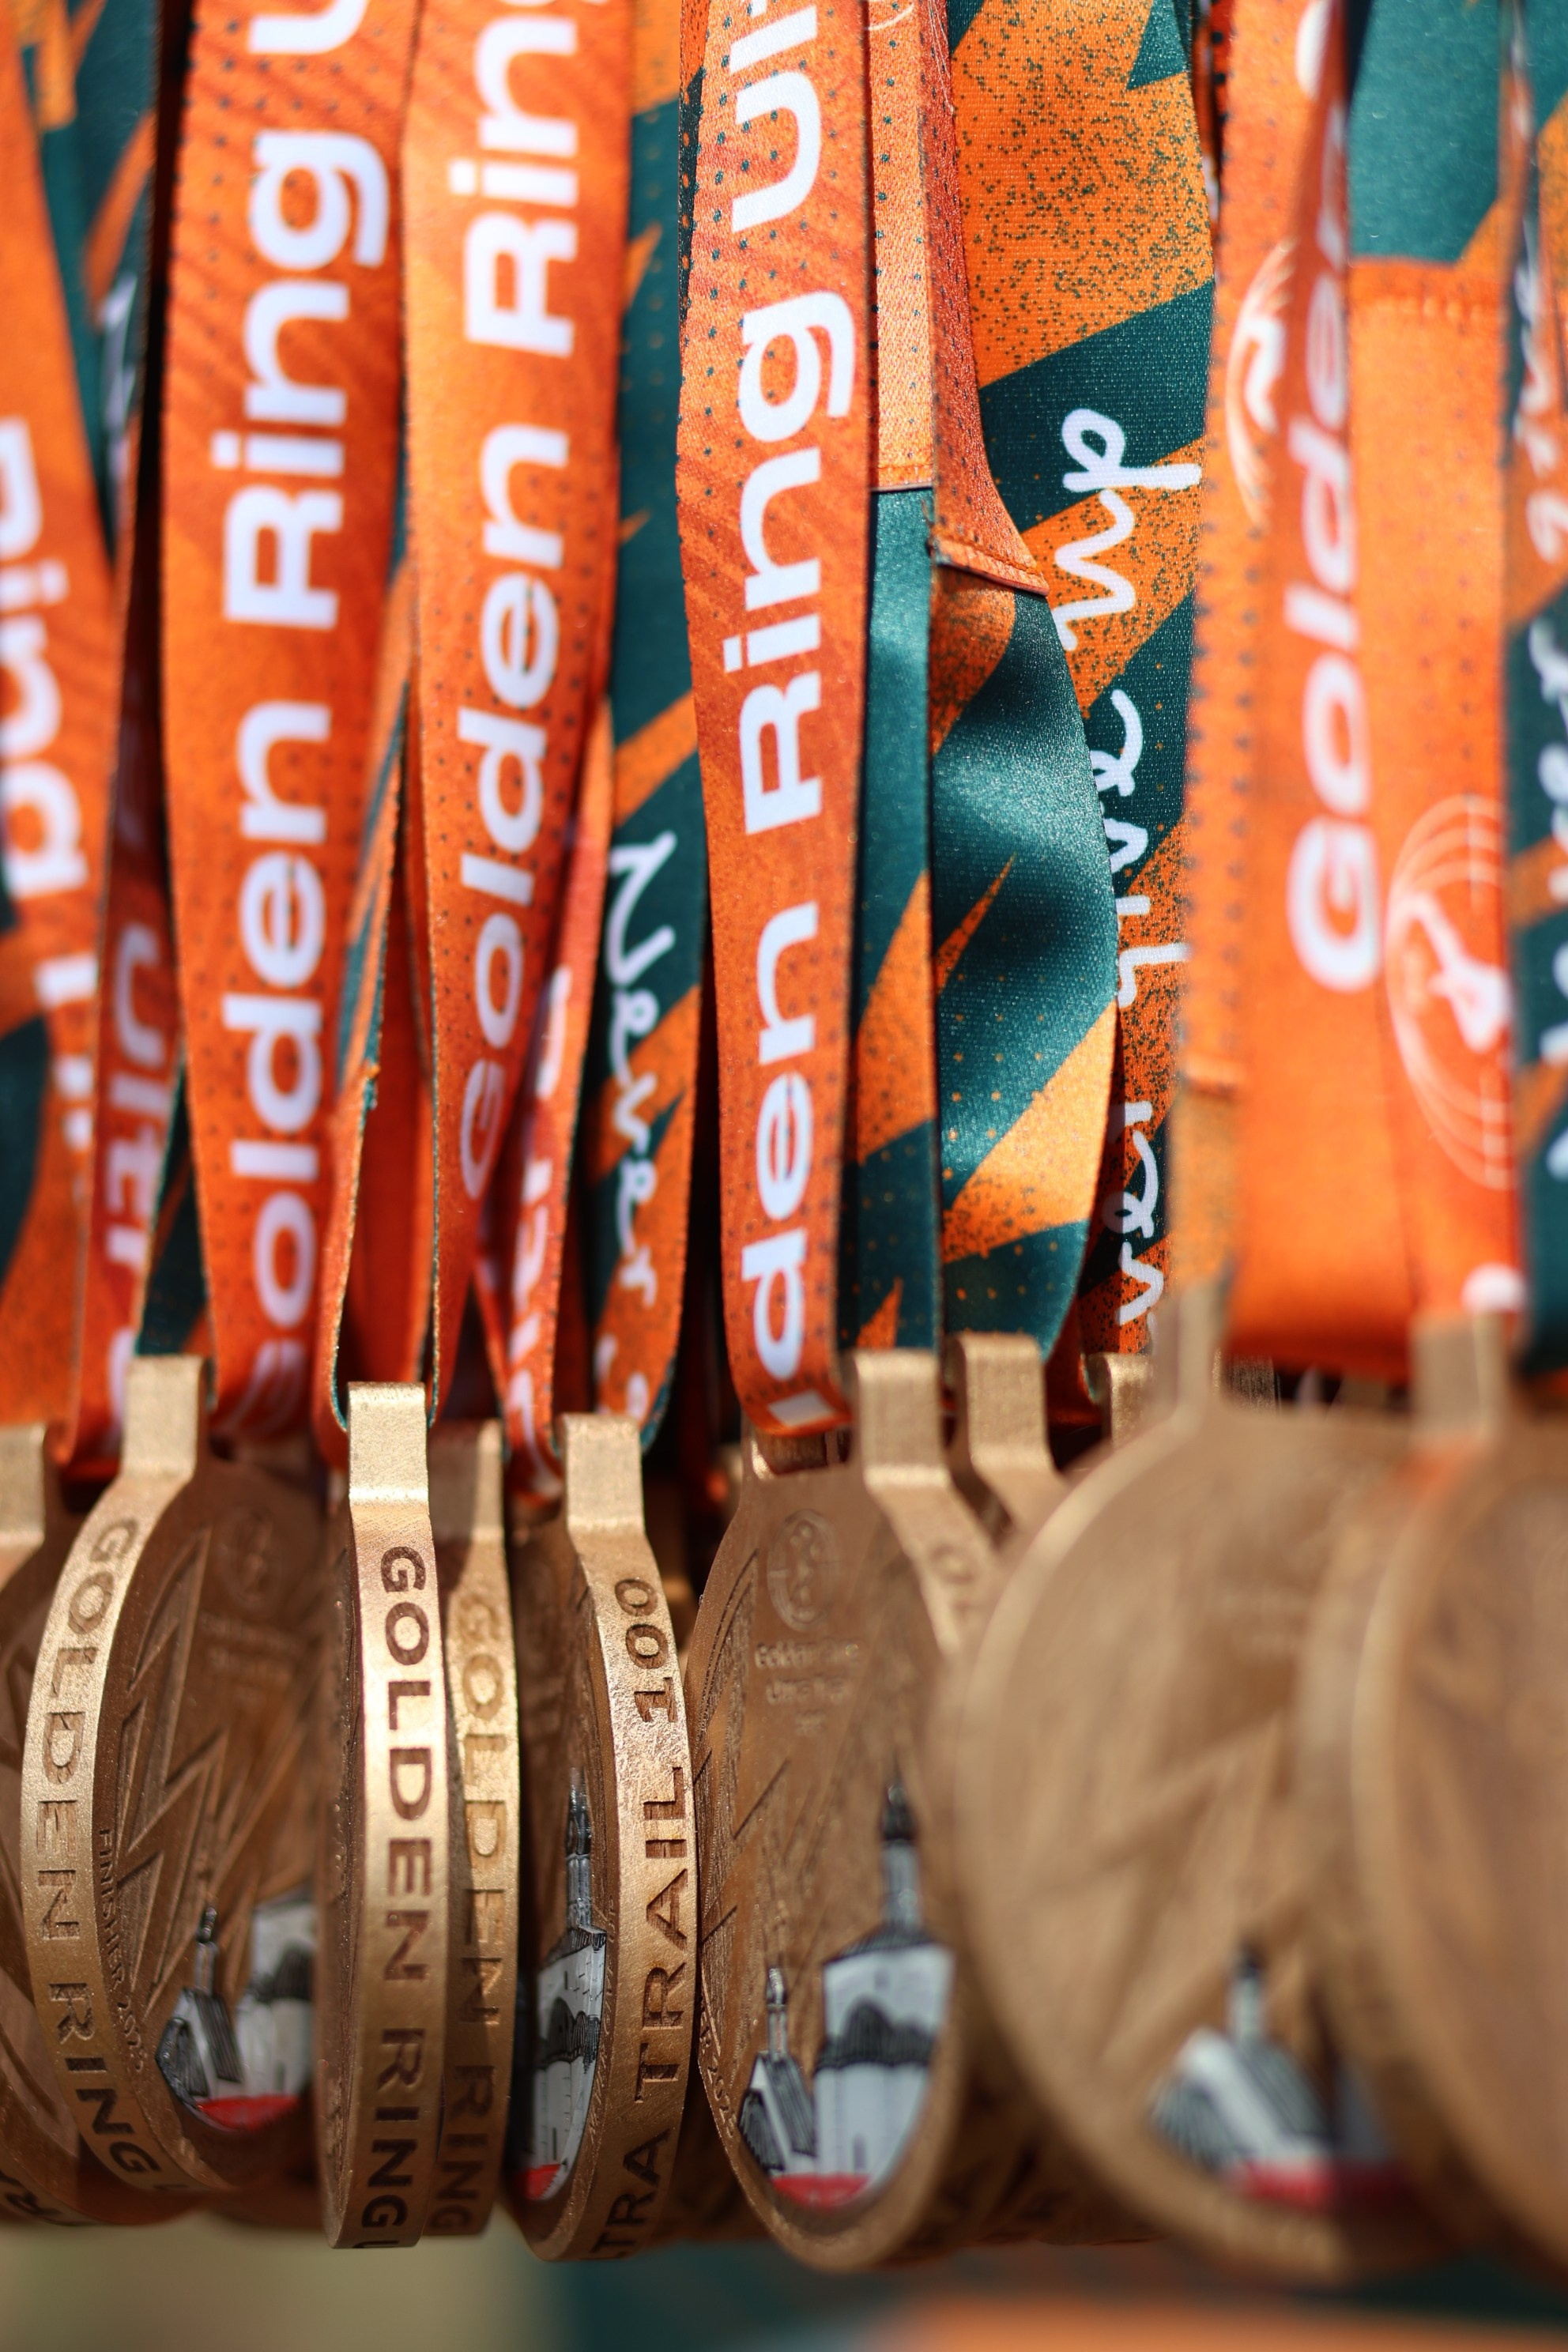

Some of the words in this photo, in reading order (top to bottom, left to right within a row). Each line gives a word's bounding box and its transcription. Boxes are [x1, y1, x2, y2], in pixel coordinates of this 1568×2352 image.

[448, 0, 579, 358] Rin
[729, 0, 822, 233] Ul
[211, 128, 390, 631] Ring
[723, 291, 856, 835] Ring
[456, 423, 571, 1200] Golden
[605, 830, 677, 1309] Never
[36, 1517, 139, 1940] GOLDEN
[380, 1545, 432, 1981] GOLDEN
[458, 1592, 507, 2026] GOLDEN
[614, 1577, 678, 1723] 100
[49, 1981, 161, 2174] RING
[99, 1827, 126, 1991] FINISHER
[634, 1766, 687, 2104] TRAIL
[361, 2028, 427, 2229] RING
[429, 2064, 496, 2230] RING
[707, 2054, 737, 2139] 2025
